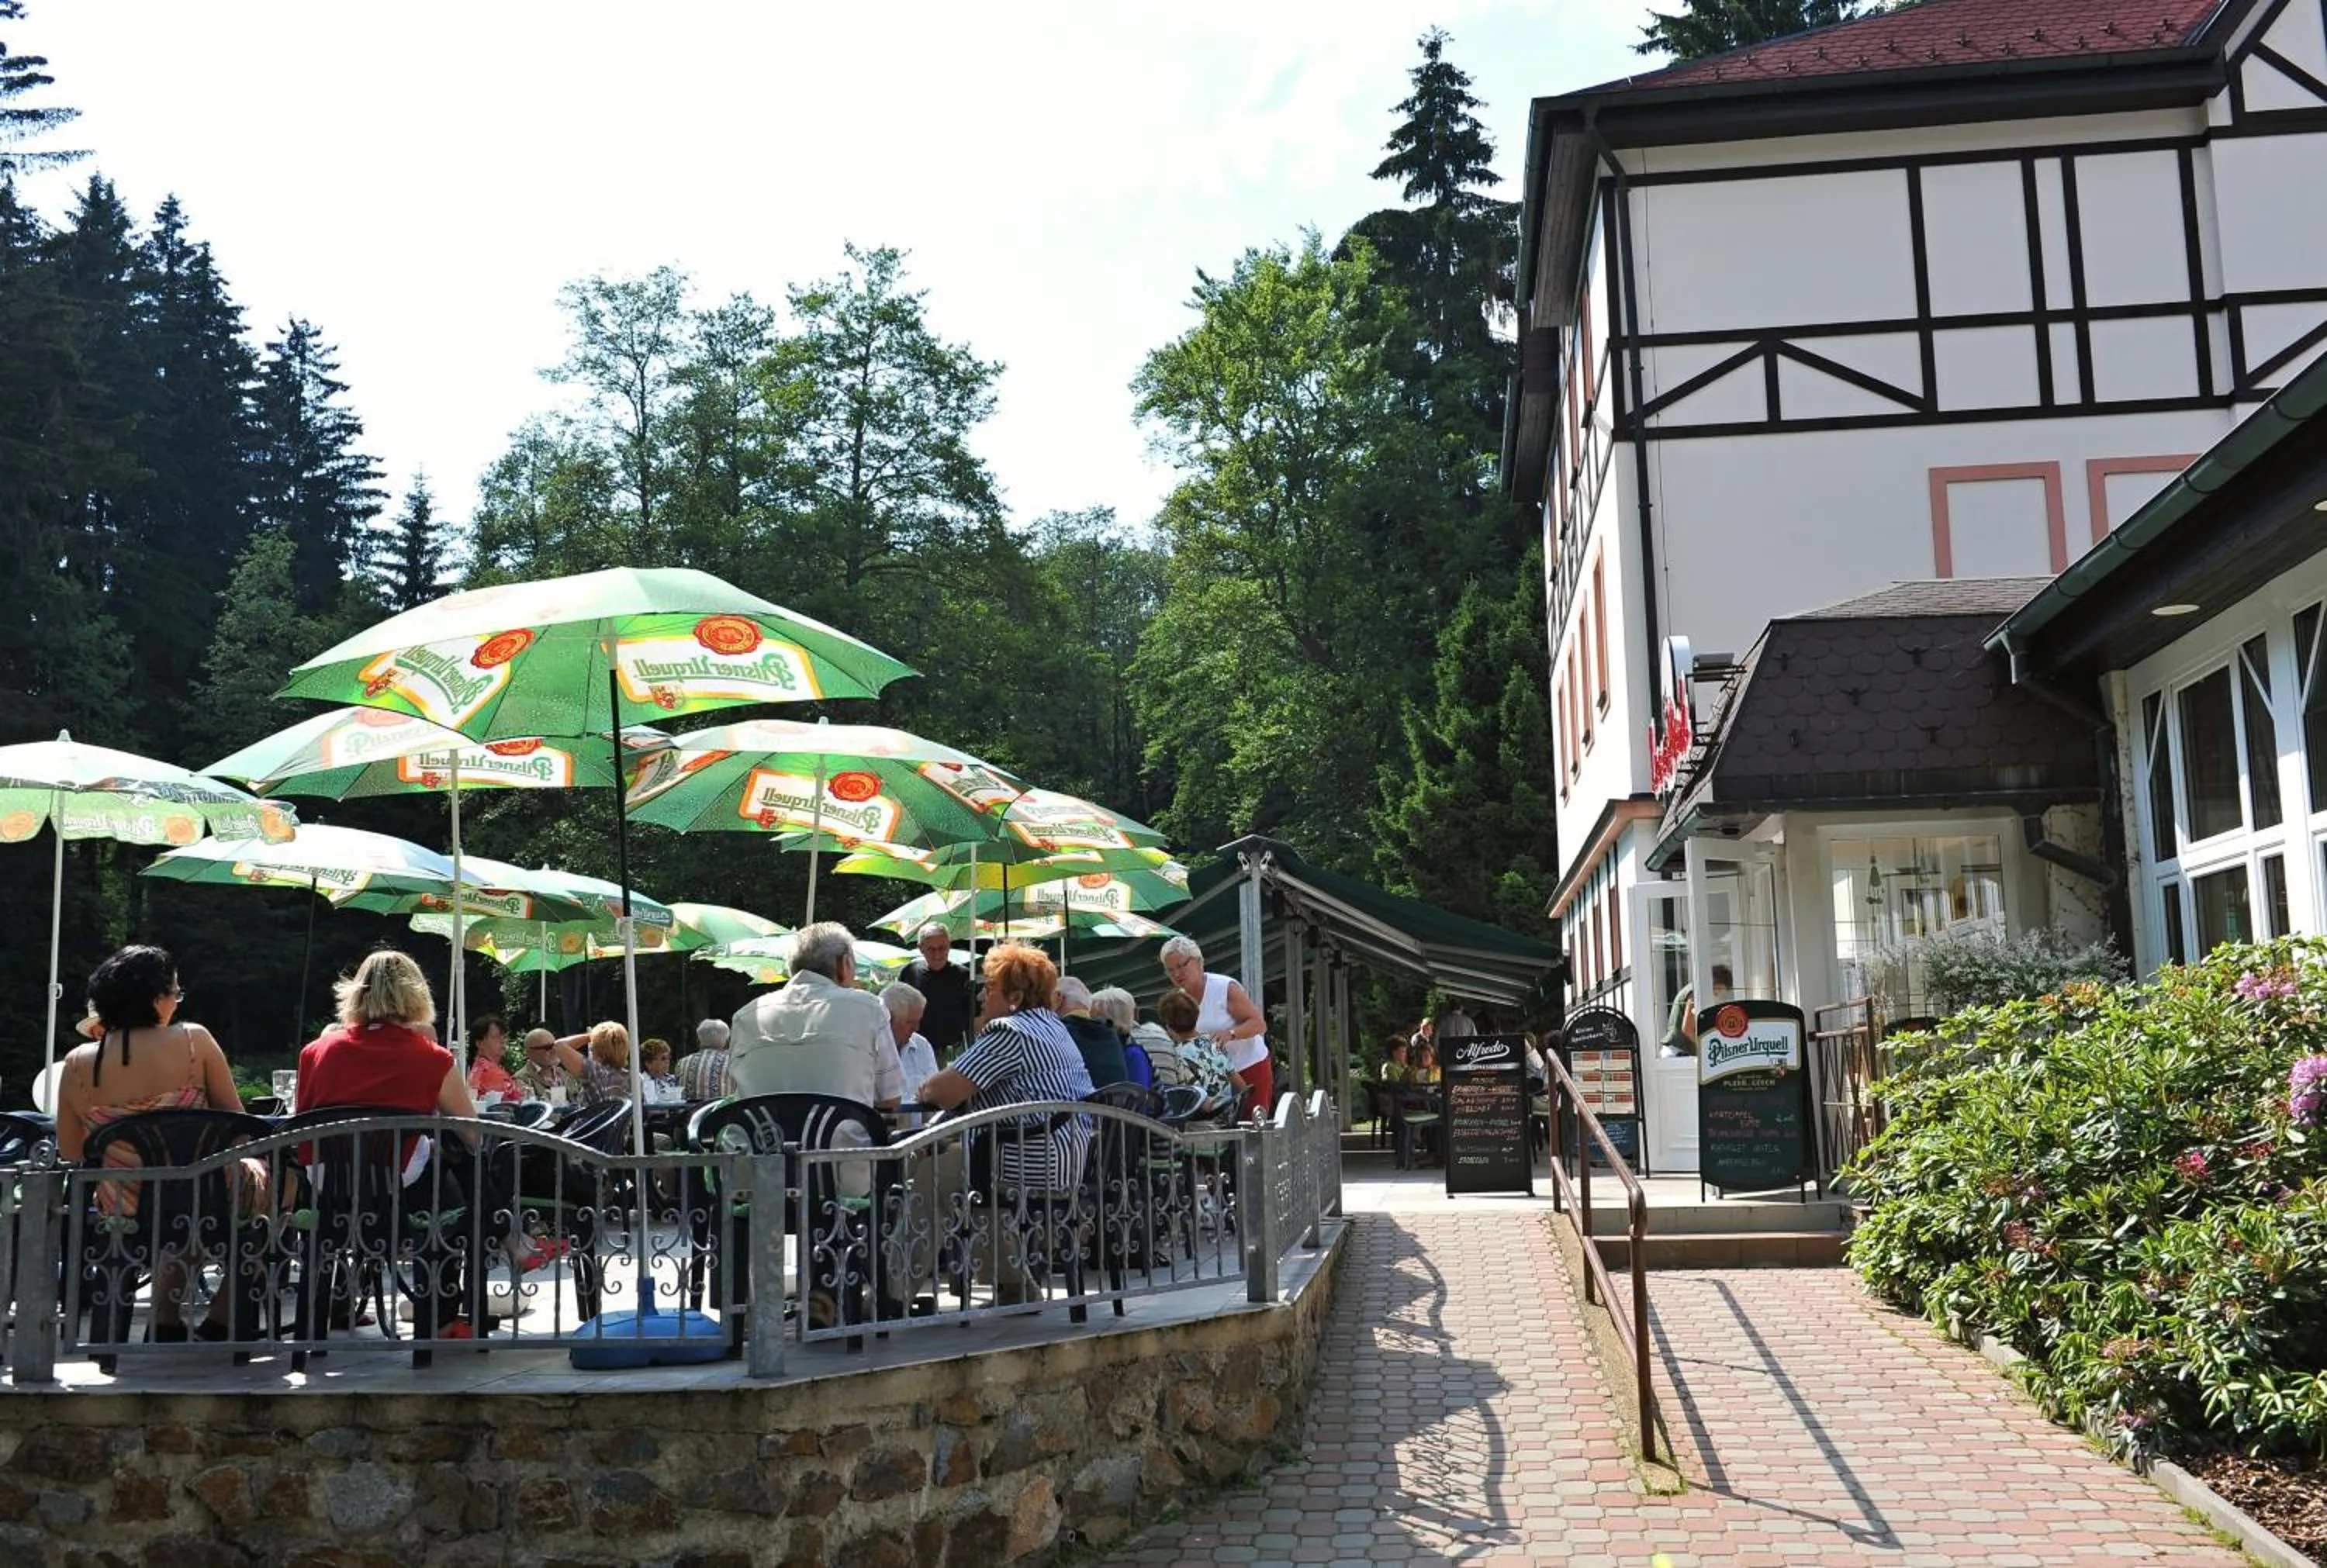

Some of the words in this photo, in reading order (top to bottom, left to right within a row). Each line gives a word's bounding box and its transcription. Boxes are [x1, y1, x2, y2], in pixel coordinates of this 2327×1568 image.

[1456, 1040, 1510, 1065] Alfredo
[1708, 1038, 1749, 1067] Pilsner
[1748, 1035, 1789, 1057] Urquell
